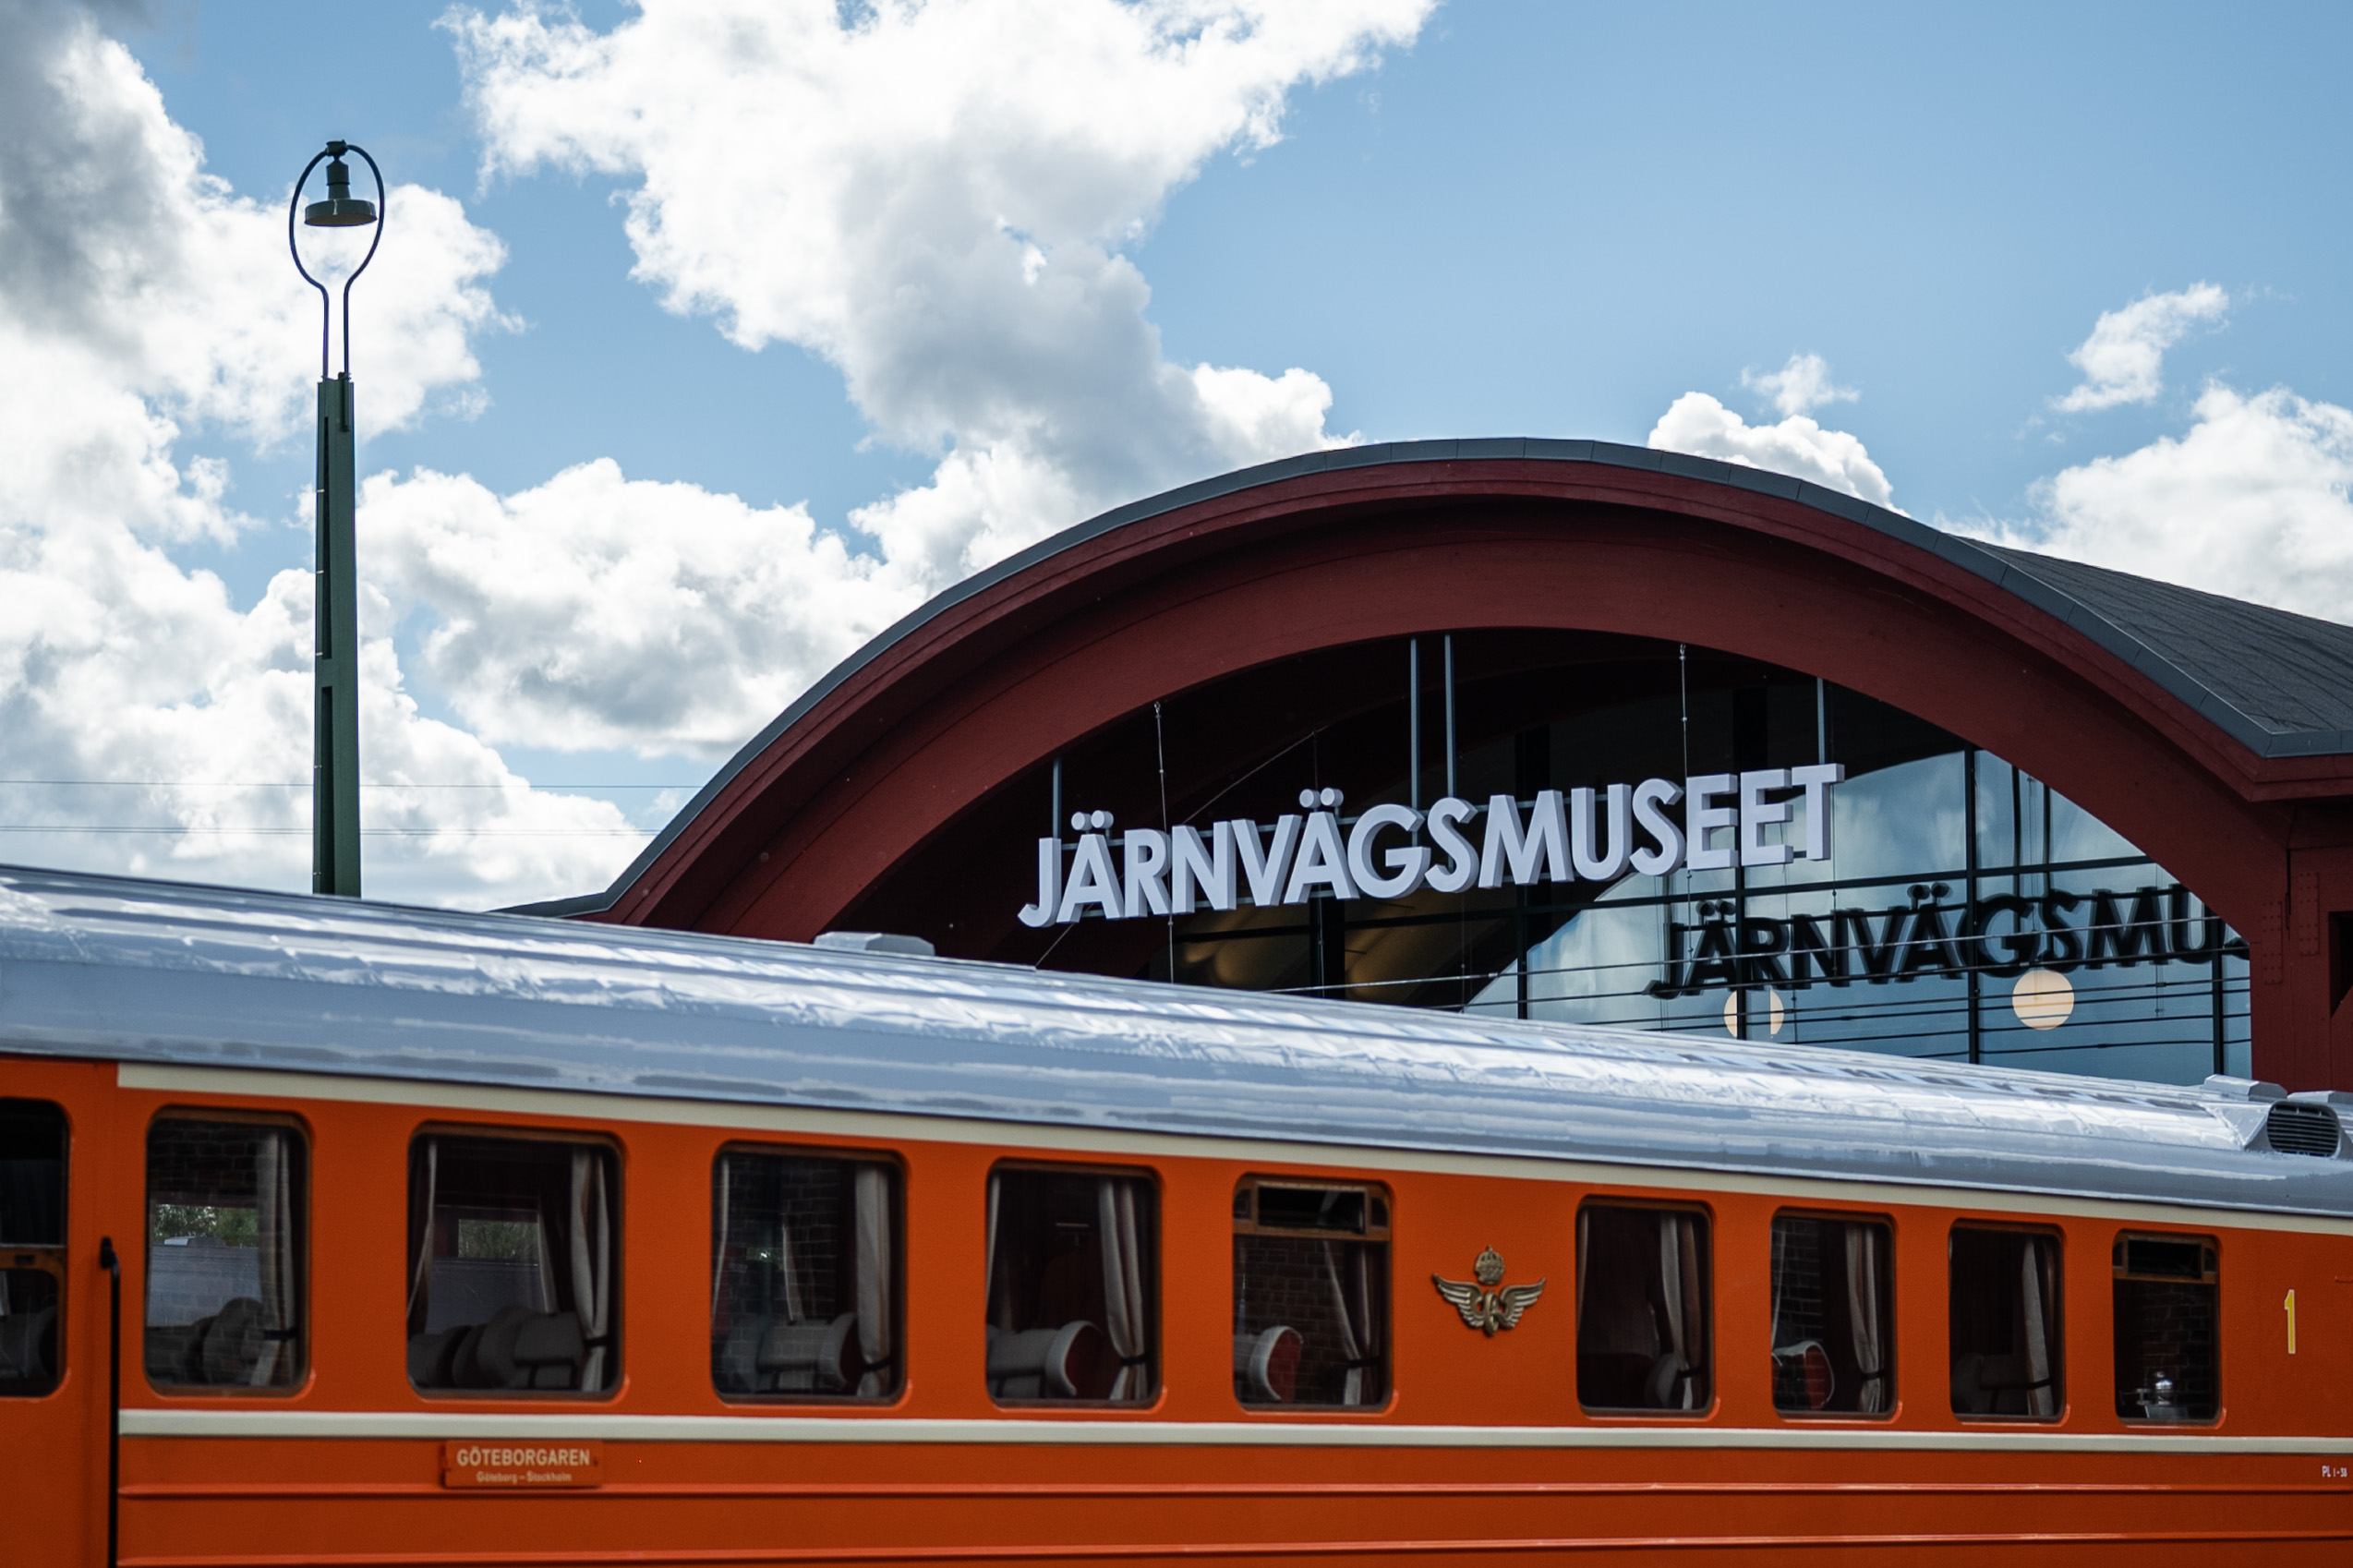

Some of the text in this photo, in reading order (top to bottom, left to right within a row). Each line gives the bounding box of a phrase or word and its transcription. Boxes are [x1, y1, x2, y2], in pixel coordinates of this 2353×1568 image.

[1018, 763, 1845, 927] JÄRNVÄGSMUSEET
[1643, 883, 2250, 1000] JÄRNVÄGSMU
[2284, 1289, 2296, 1355] 1
[456, 1445, 590, 1466] GÖTEBORGAREN
